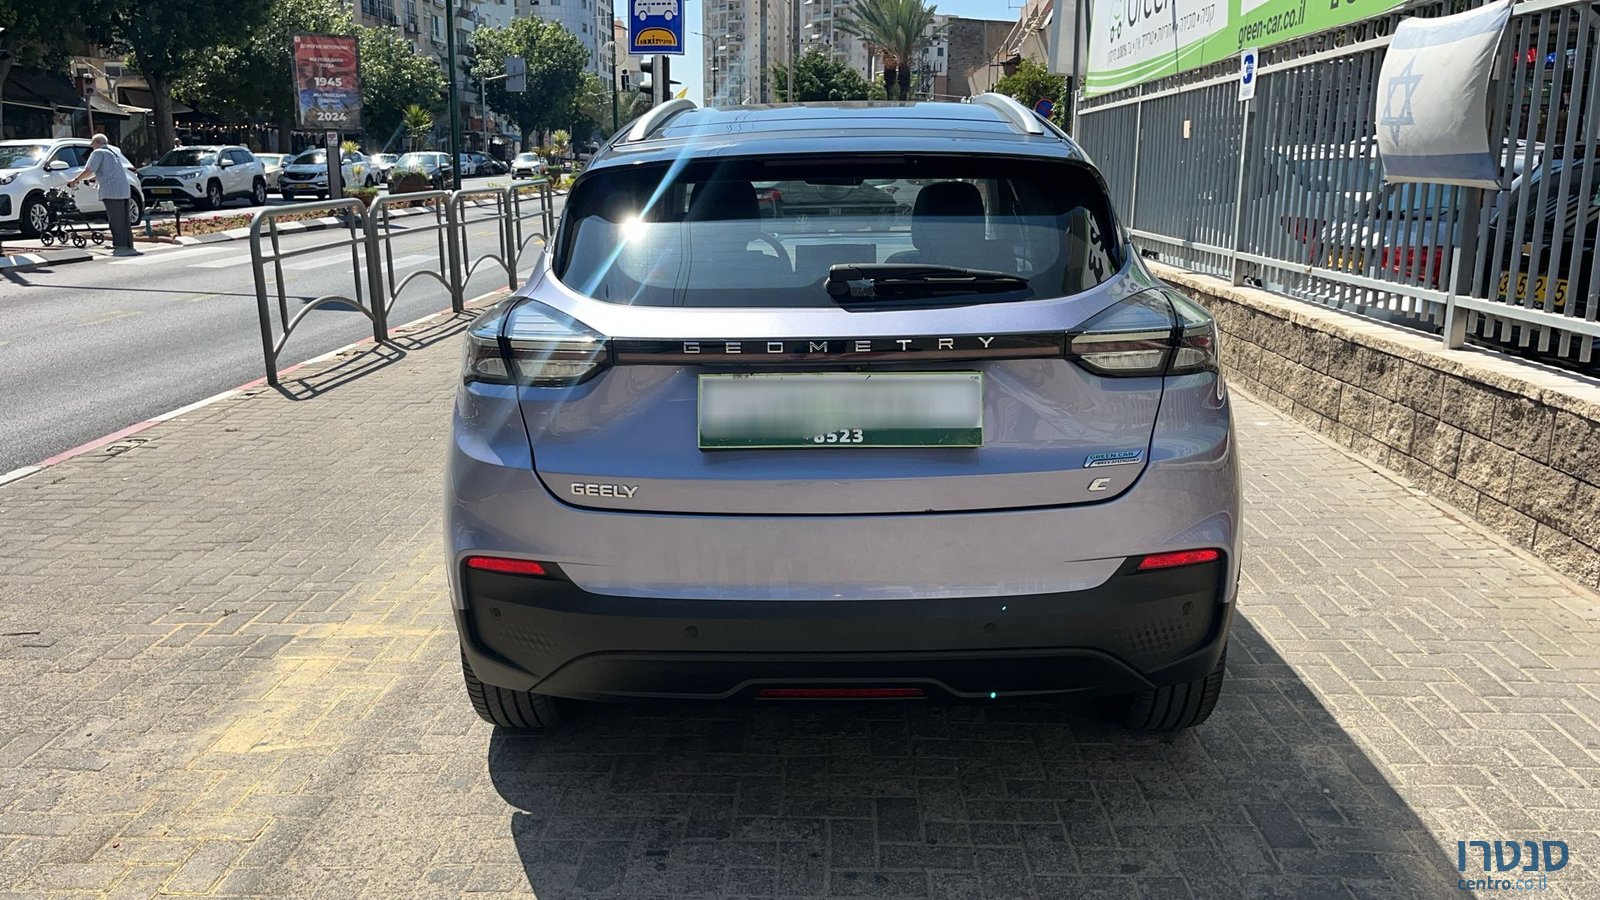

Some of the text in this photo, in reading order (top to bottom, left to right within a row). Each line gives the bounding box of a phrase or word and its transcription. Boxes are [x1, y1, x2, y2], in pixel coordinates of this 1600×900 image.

[1238, 3, 1305, 49] green-car.co.il
[314, 77, 342, 87] 1945
[317, 111, 347, 121] 2024
[683, 336, 995, 354] GEOMETRY
[570, 483, 639, 498] GEELY
[1088, 478, 1111, 491] C
